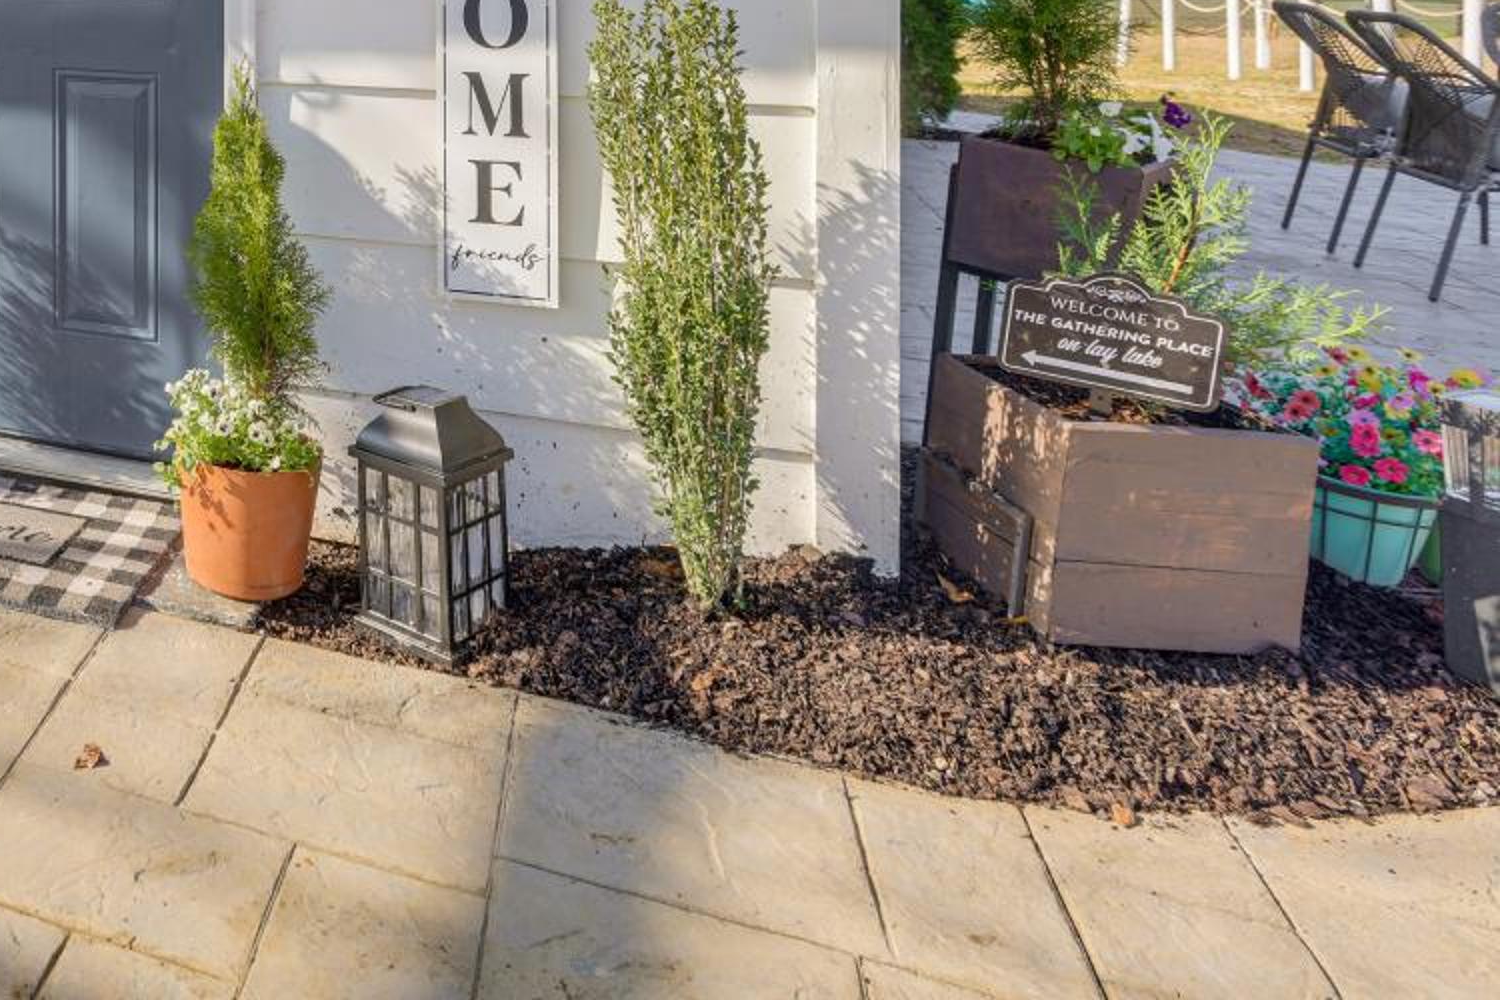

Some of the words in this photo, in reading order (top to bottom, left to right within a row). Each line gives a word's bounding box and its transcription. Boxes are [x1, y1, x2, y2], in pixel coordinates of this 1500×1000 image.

[451, 244, 543, 270] friends
[1050, 297, 1149, 328] WELCOME
[1155, 317, 1180, 331] TO
[1014, 309, 1048, 325] THE
[1050, 317, 1151, 345] GATHERING
[1156, 337, 1214, 358] PLACE
[1057, 338, 1082, 351] on
